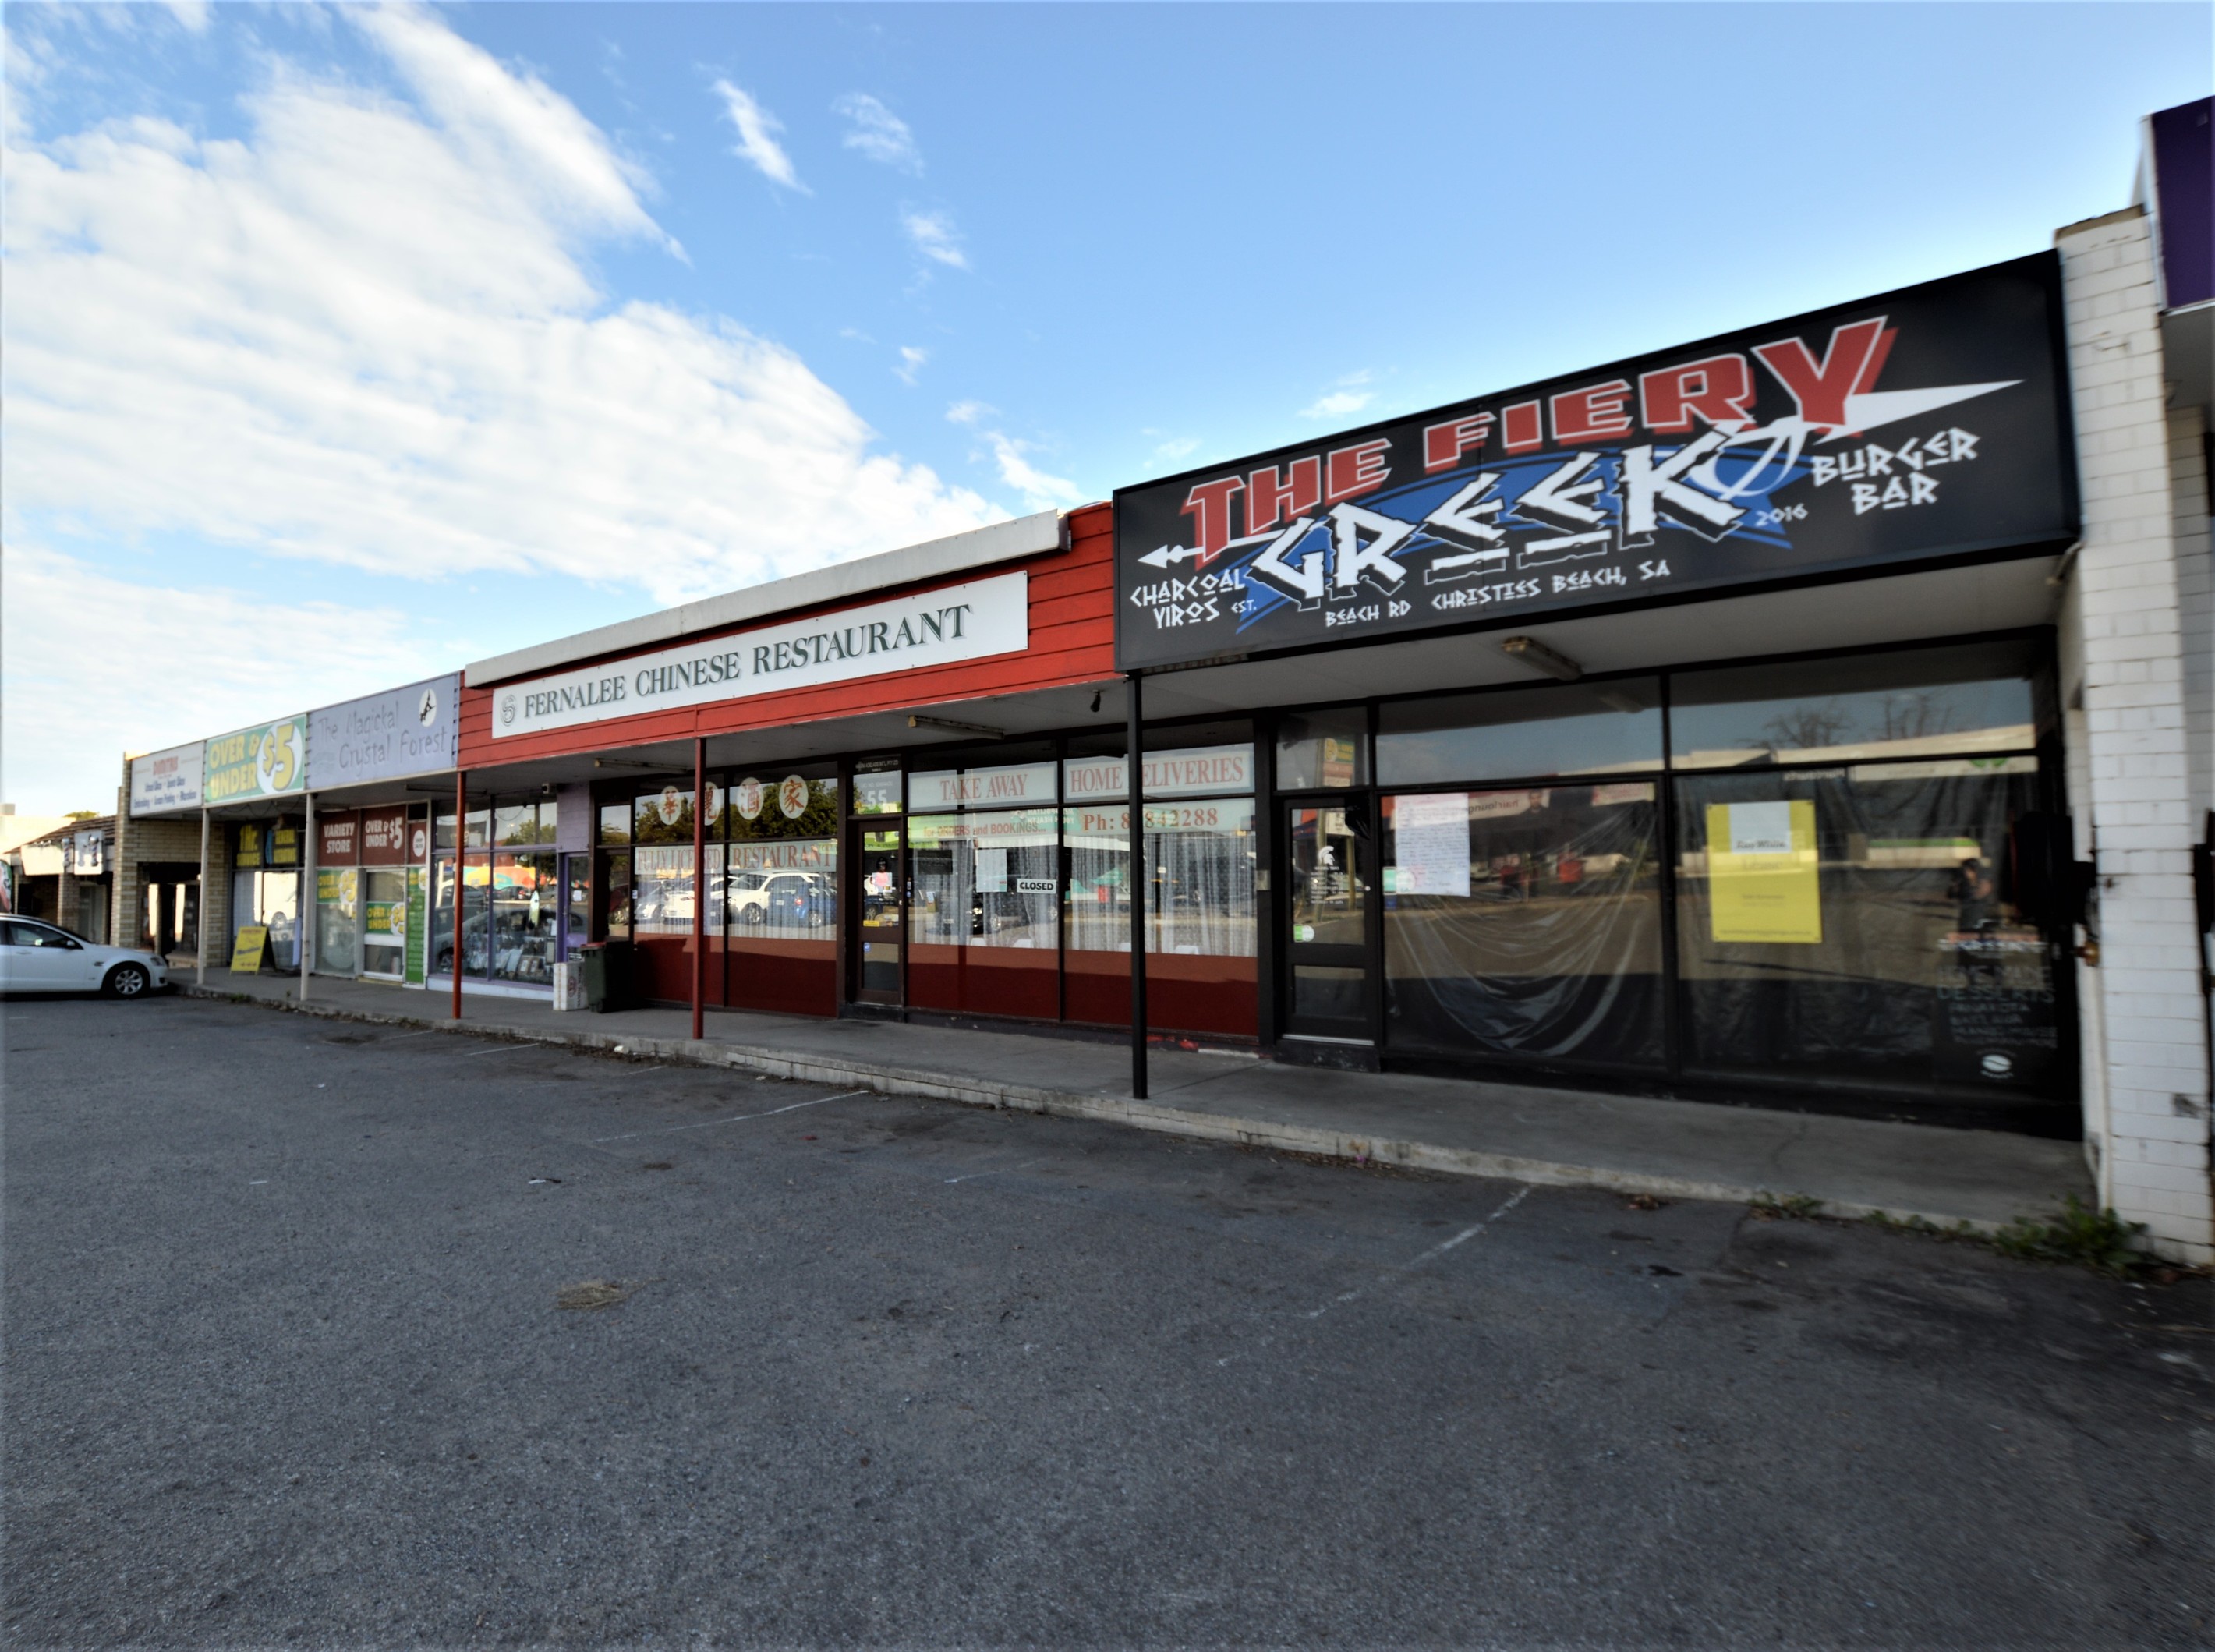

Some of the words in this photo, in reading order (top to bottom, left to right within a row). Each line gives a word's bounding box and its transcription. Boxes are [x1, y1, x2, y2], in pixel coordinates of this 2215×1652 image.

[1180, 438, 1392, 571] THE
[1424, 315, 1898, 474] FIERY
[1810, 426, 1981, 487] BURGER
[1851, 472, 1940, 516] BAR
[1245, 427, 1746, 611] GREEK
[1231, 599, 1257, 614] EST.
[1754, 503, 1809, 527] 2016
[1130, 568, 1245, 607] CHARCOAL
[1431, 578, 1541, 610] CHRISTIES
[1552, 566, 1627, 593] BEACH,
[1638, 559, 1670, 581] SA
[1325, 604, 1379, 628] BEACH
[1389, 600, 1412, 618] RD
[524, 675, 626, 719] FERNALEE
[635, 652, 741, 697] CHINESE
[753, 603, 972, 675] RESTAURANT
[318, 717, 338, 744] The
[346, 701, 399, 743] Magickal
[209, 735, 246, 769] OVER
[209, 762, 257, 799] UNDER
[262, 723, 295, 791] $5
[338, 734, 391, 776] Crystal
[399, 726, 447, 763] Forest
[940, 776, 982, 801] TAKE
[986, 773, 1028, 798] AWAY
[1070, 766, 1123, 793] HOME
[1141, 756, 1244, 787] ELIVERIES
[323, 822, 356, 838] VARIETY
[365, 820, 383, 833] OVER
[365, 834, 387, 847] UNDER
[389, 817, 403, 850] $5
[937, 824, 971, 837] ORDERS
[971, 823, 989, 835] and
[1083, 813, 1114, 831] Ph:
[1121, 808, 1219, 830] 8842288
[326, 839, 352, 854] STORE
[637, 849, 668, 872] FULLY
[671, 847, 720, 870] LICEED
[733, 844, 832, 869] RESTAURANT
[1019, 882, 1054, 891] CLOSED
[366, 907, 385, 918] OVER
[367, 918, 391, 930] UNDER
